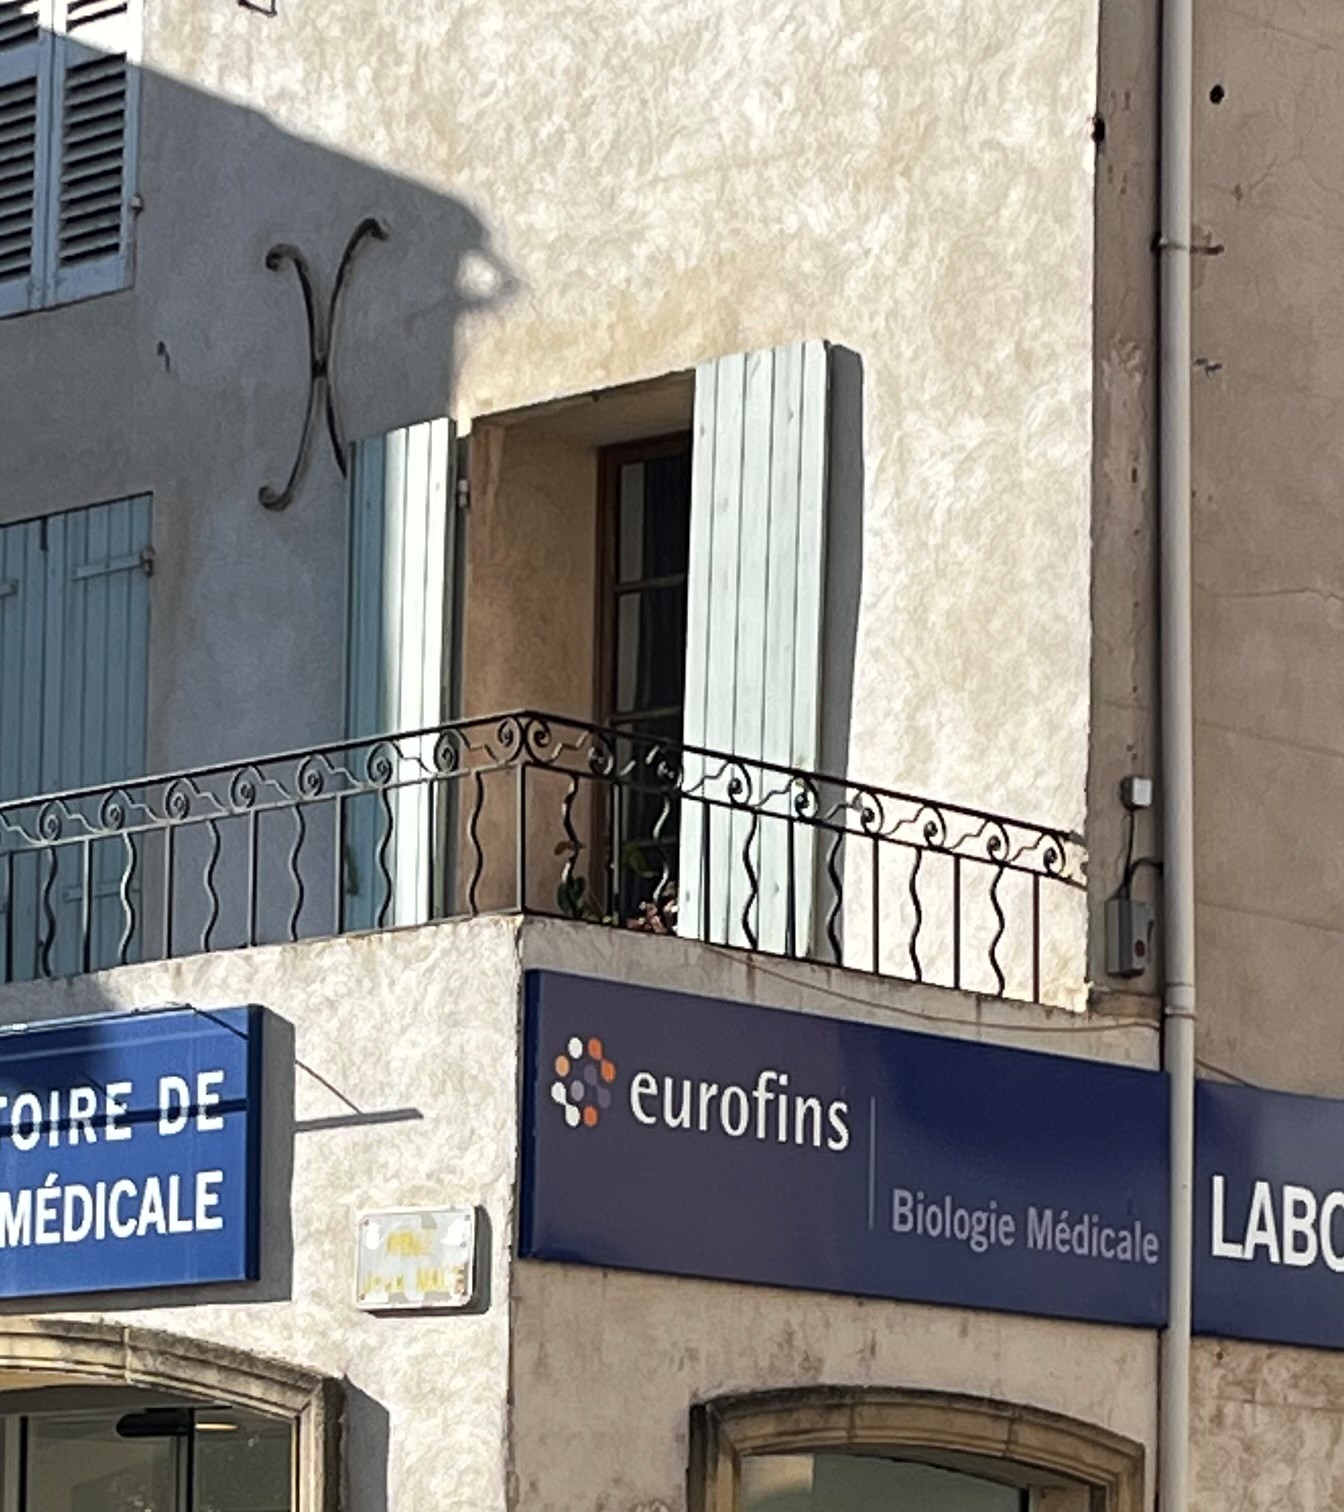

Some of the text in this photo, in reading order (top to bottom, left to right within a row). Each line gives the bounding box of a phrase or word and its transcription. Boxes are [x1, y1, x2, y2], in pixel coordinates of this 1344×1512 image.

[158, 1070, 225, 1137] DE
[629, 1070, 850, 1151] eurofins
[891, 1187, 1159, 1263] Biologie Médicale
